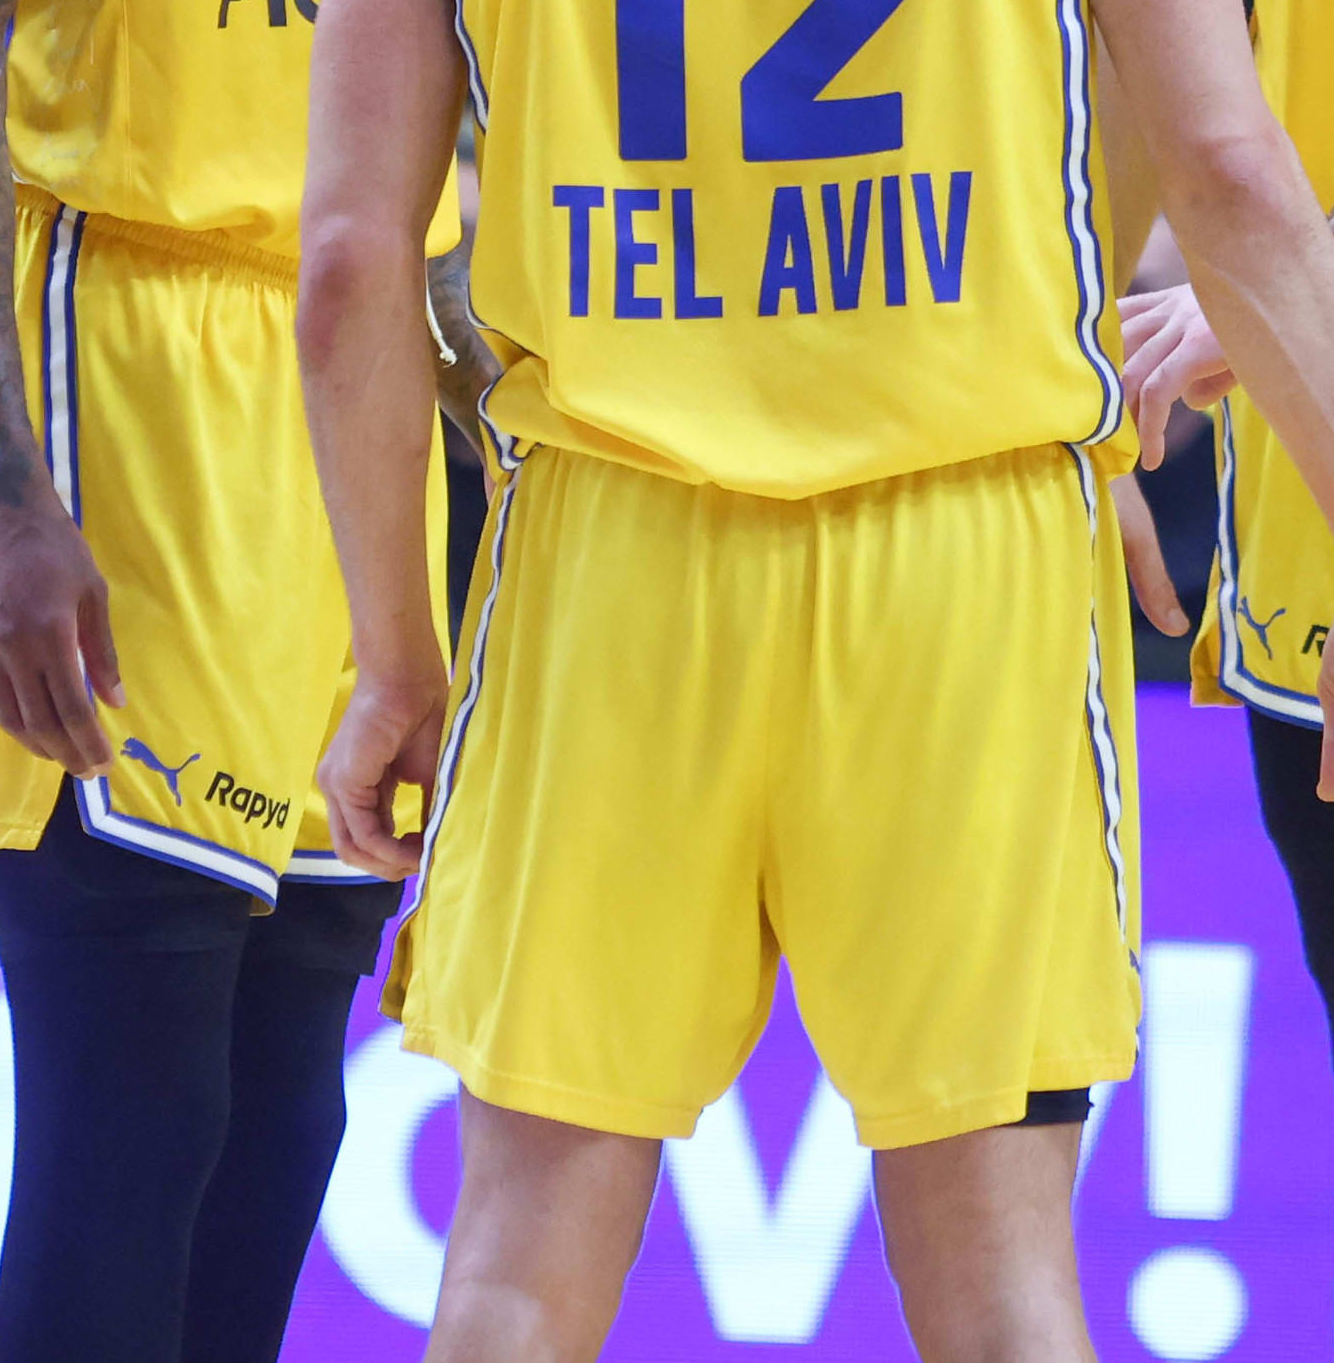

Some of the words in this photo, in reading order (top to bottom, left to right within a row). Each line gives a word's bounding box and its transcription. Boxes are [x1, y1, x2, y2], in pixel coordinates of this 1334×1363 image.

[553, 184, 723, 320] TEL
[758, 171, 973, 319] AVIV
[203, 770, 291, 830] Rapyd
